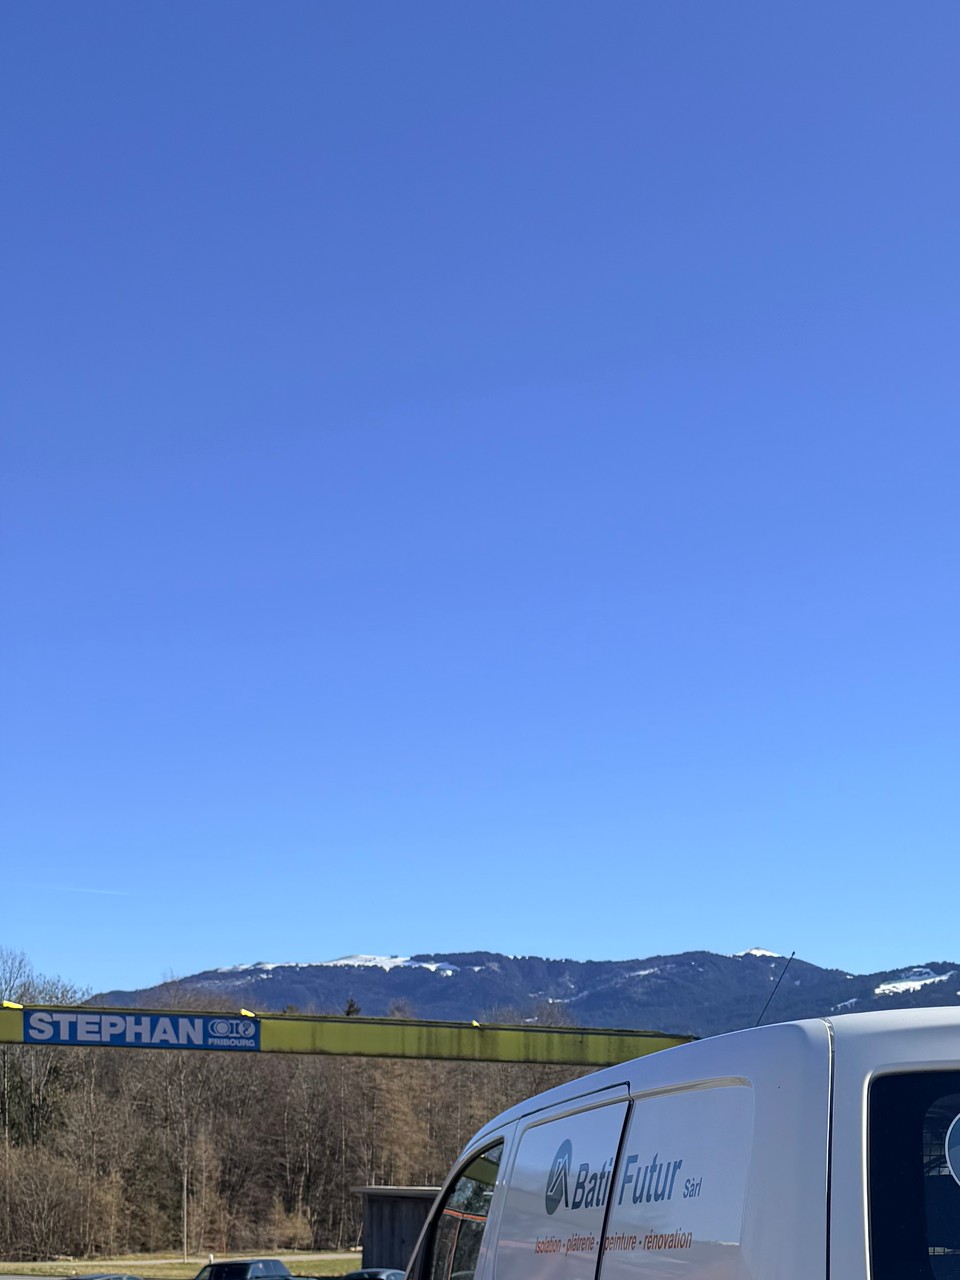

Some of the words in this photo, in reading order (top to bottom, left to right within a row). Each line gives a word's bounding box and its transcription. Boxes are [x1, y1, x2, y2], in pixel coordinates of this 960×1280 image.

[28, 1012, 203, 1045] STEPHAN
[208, 1038, 255, 1047] FRIBOURG
[571, 1157, 613, 1210] Bati
[618, 1152, 683, 1205] Futur
[643, 1227, 693, 1250] rénovation
